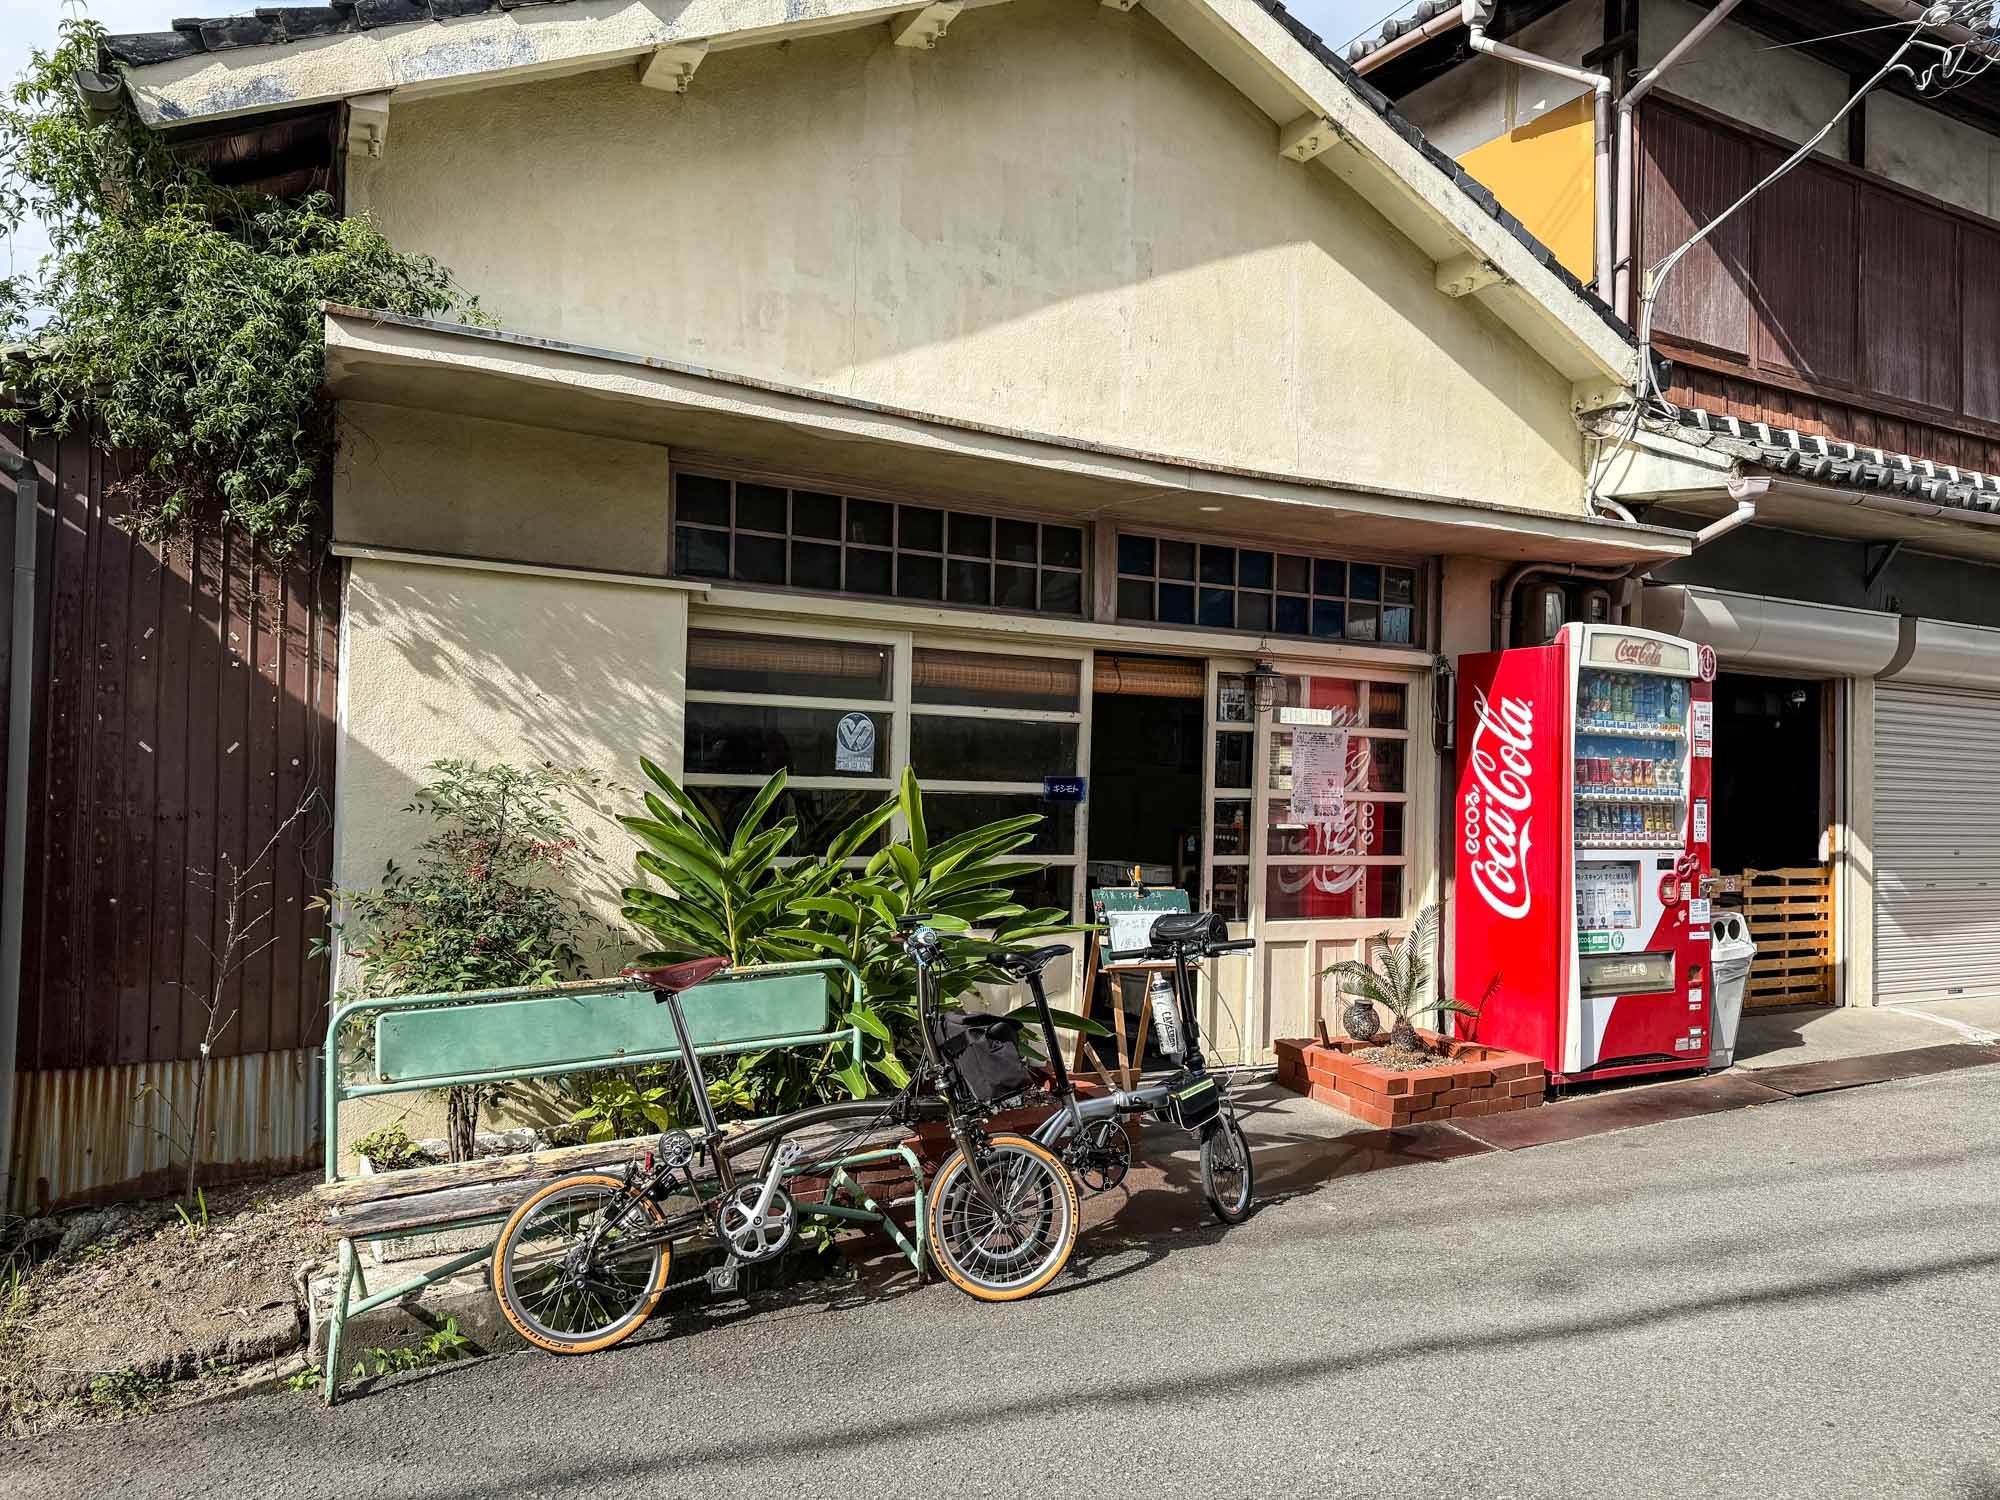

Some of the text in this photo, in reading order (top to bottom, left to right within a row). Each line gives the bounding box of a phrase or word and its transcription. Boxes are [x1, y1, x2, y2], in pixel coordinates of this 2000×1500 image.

[1053, 784, 1079, 793] キシモト
[1471, 684, 1534, 920] Coca-Cola
